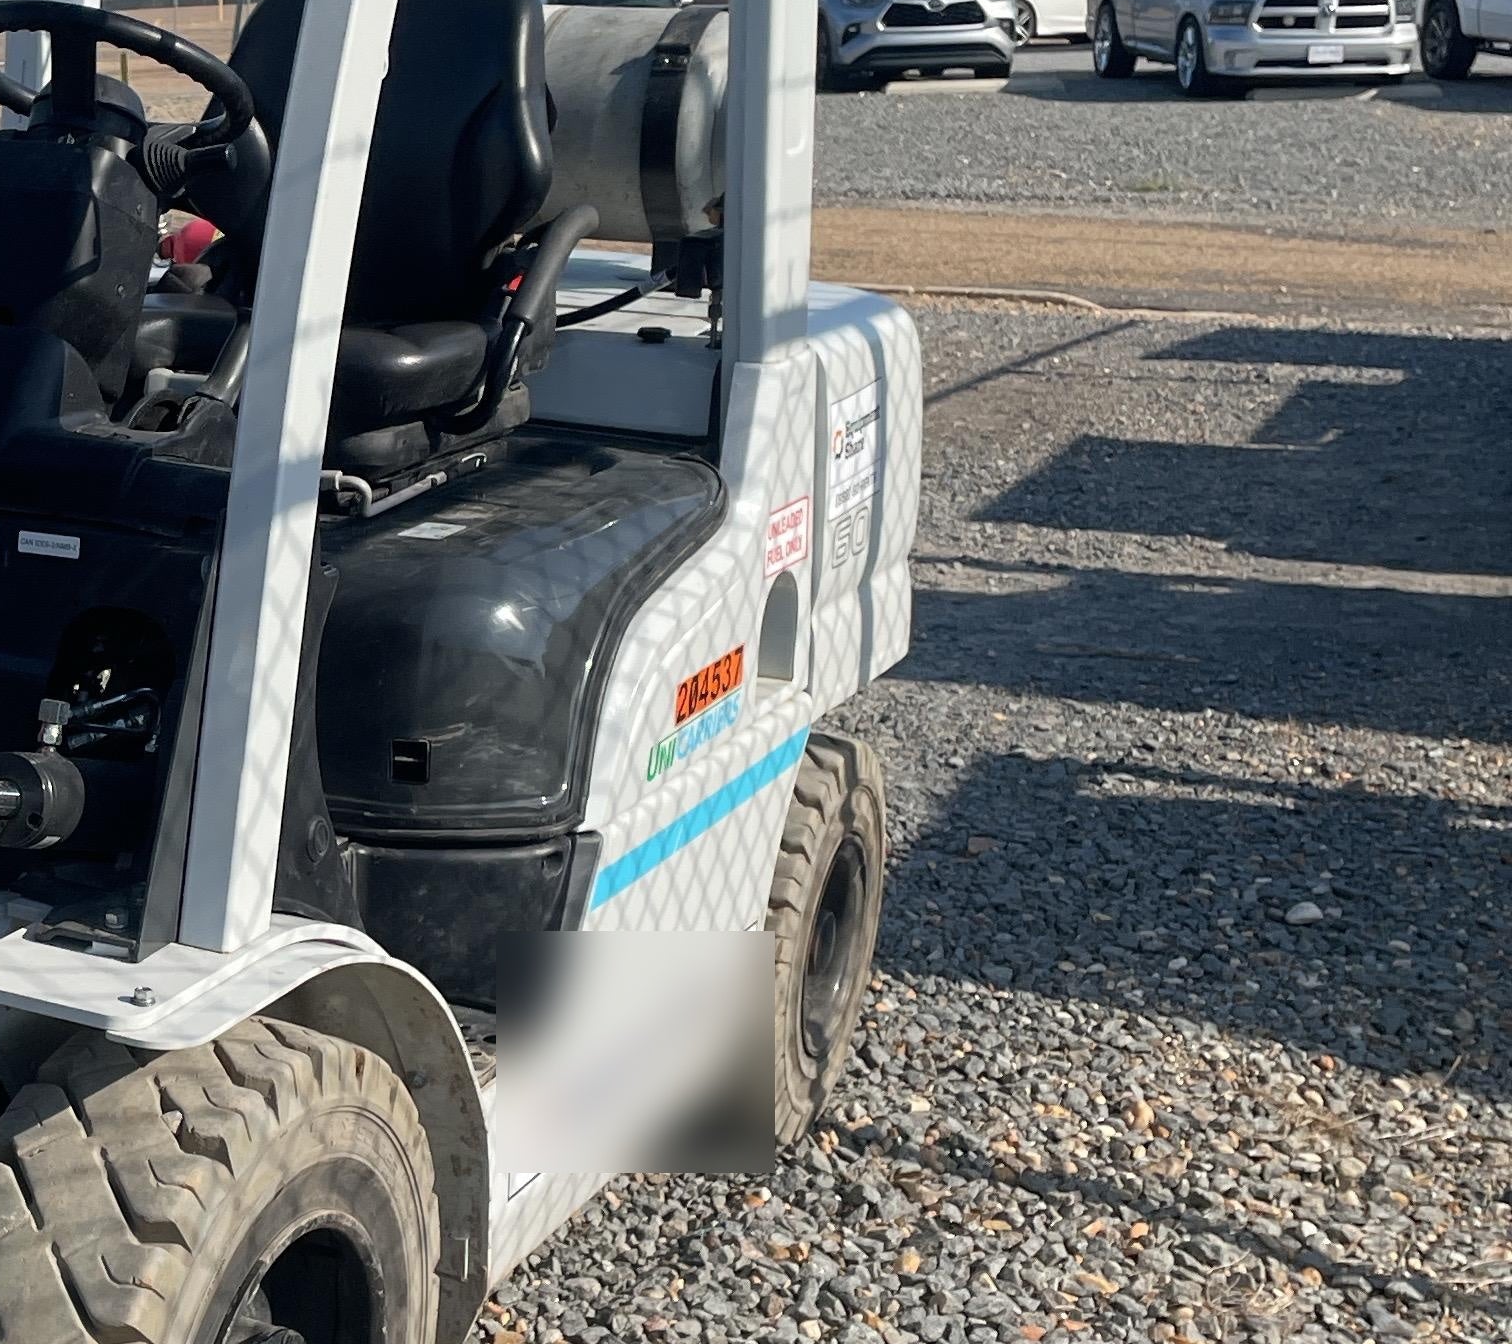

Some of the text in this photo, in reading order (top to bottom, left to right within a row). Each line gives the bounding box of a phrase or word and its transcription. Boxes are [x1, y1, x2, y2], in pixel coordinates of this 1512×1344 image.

[767, 535, 803, 568] FUEL ONLY
[676, 645, 745, 724] 204537
